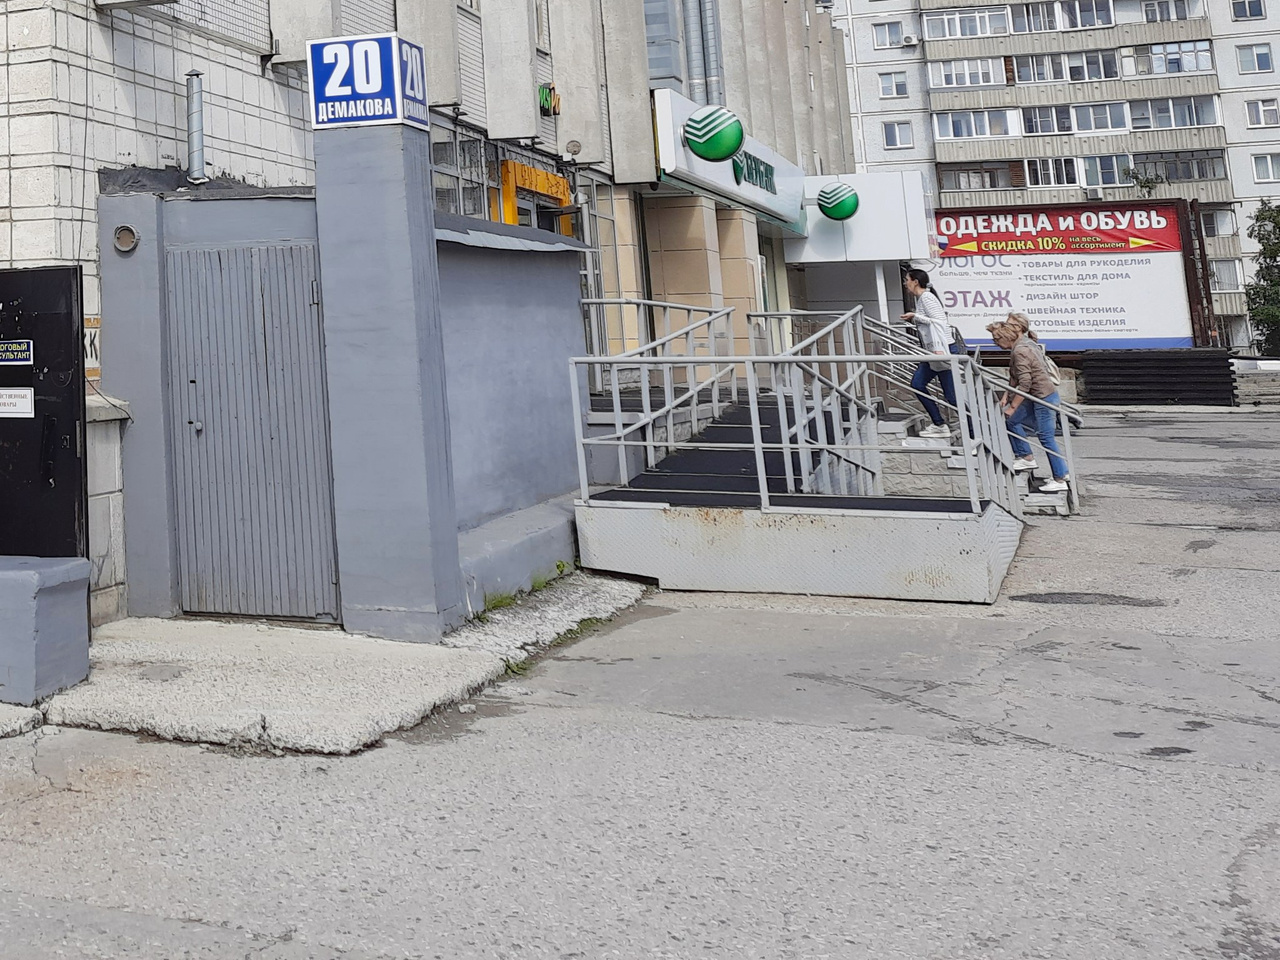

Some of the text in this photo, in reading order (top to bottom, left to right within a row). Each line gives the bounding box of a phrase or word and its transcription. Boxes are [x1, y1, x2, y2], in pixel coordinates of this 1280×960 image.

[322, 40, 382, 97] 20
[401, 43, 424, 100] 20
[318, 98, 393, 122] ДЕМАКОВА
[939, 210, 1168, 238] ОДЕЖДА и ОБУВЬ
[981, 237, 1066, 252] СКИДКА 10%
[1071, 242, 1126, 250] ассортимент
[1066, 260, 1087, 268] ДЛЯ
[1090, 258, 1151, 267] РУКОДЕЛИЯ
[1077, 273, 1098, 281] ДЛЯ
[1101, 272, 1131, 280] ДОМА
[943, 290, 1013, 308] ЭТАЖ
[1026, 292, 1099, 301] ДИЗАЙН ШТОР
[1027, 306, 1126, 315] ШВЕЙНАЯ ТЕХНИКА
[1078, 318, 1126, 328] ИЗДЕЛИЯ
